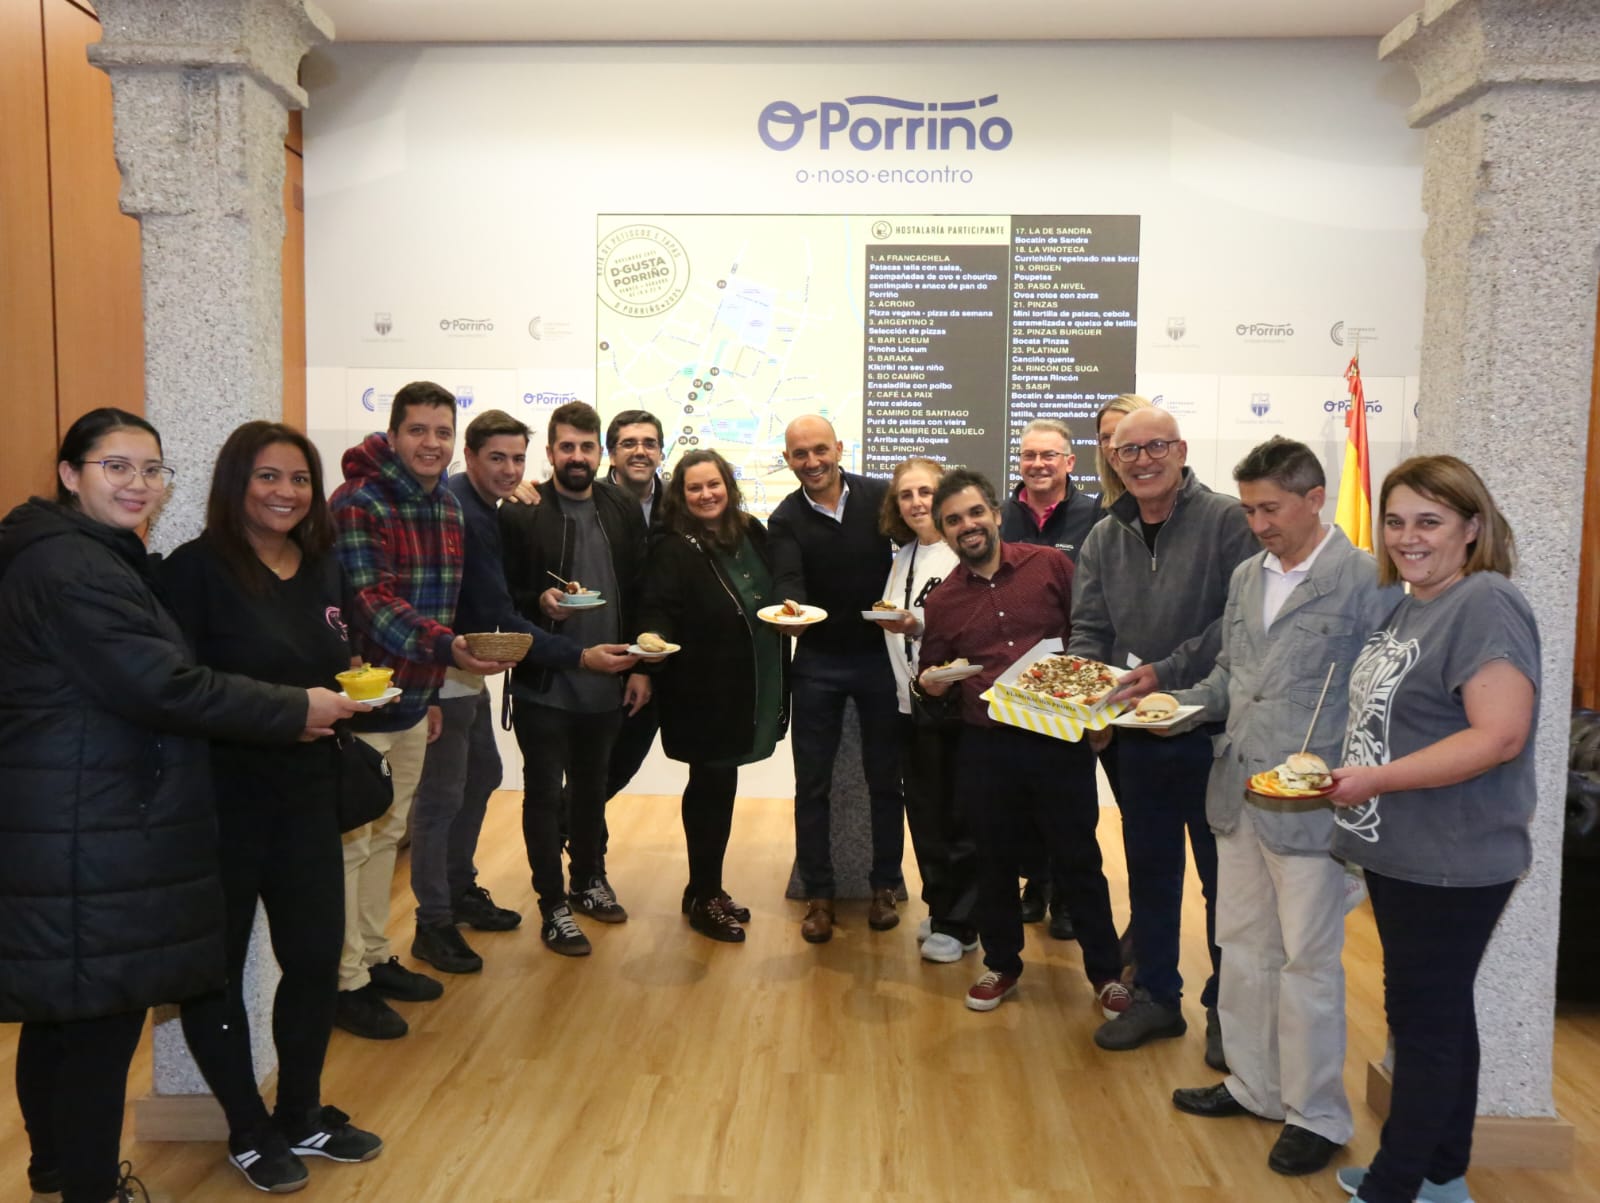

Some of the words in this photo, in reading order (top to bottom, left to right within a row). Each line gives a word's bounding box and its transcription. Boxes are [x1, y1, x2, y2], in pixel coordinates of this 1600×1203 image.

[758, 100, 817, 151] O
[948, 226, 1004, 234] PARTICIPANTE
[613, 266, 669, 288] PORRIÑO
[939, 273, 953, 281] ovo
[962, 273, 997, 281] chourizo
[892, 309, 920, 317] vegana
[1014, 310, 1030, 318] Mini
[869, 327, 907, 336] Selección
[909, 327, 919, 336] de
[1050, 374, 1078, 382] Rincón
[913, 382, 927, 390] con
[1044, 392, 1053, 400] de
[867, 418, 885, 426] Puré
[928, 418, 942, 426] con
